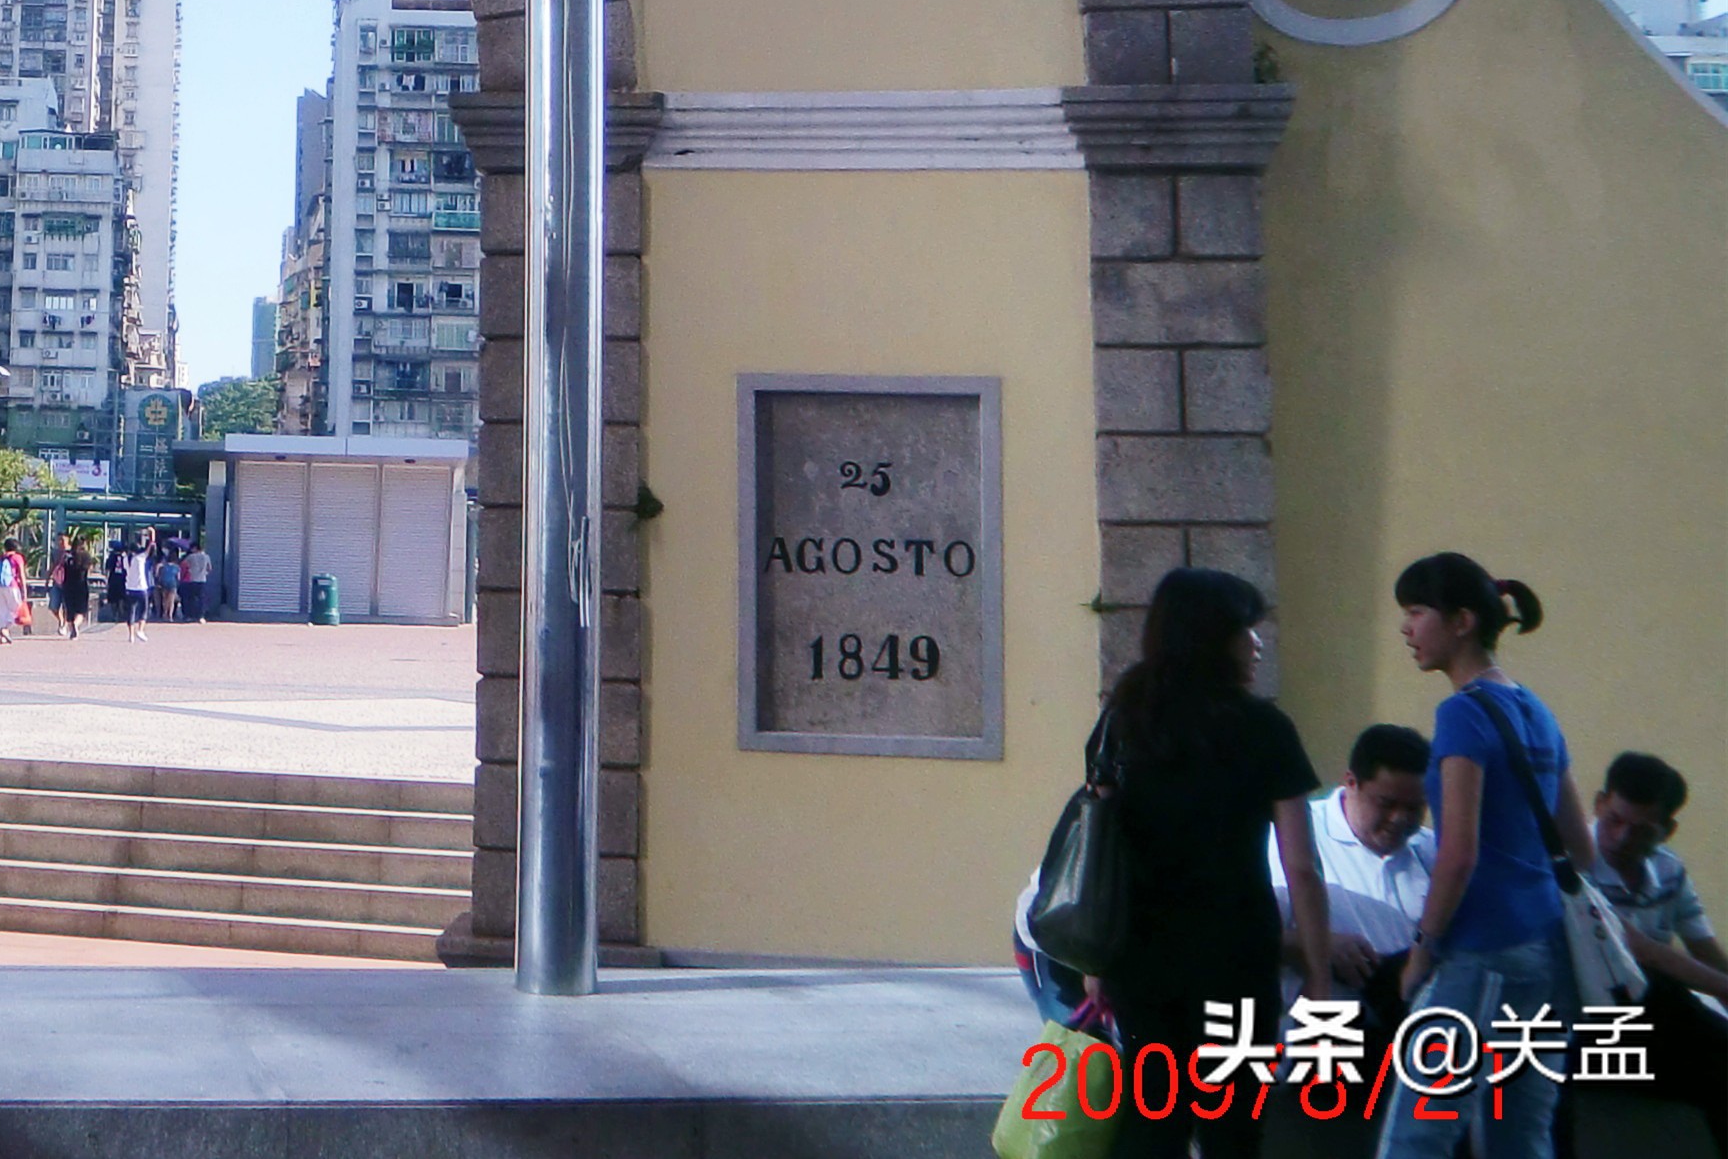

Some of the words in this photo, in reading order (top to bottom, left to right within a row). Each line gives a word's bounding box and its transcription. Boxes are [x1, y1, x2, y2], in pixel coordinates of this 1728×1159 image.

[838, 460, 893, 497] 25
[764, 536, 977, 578] AGOSTO
[808, 632, 941, 682] 1849
